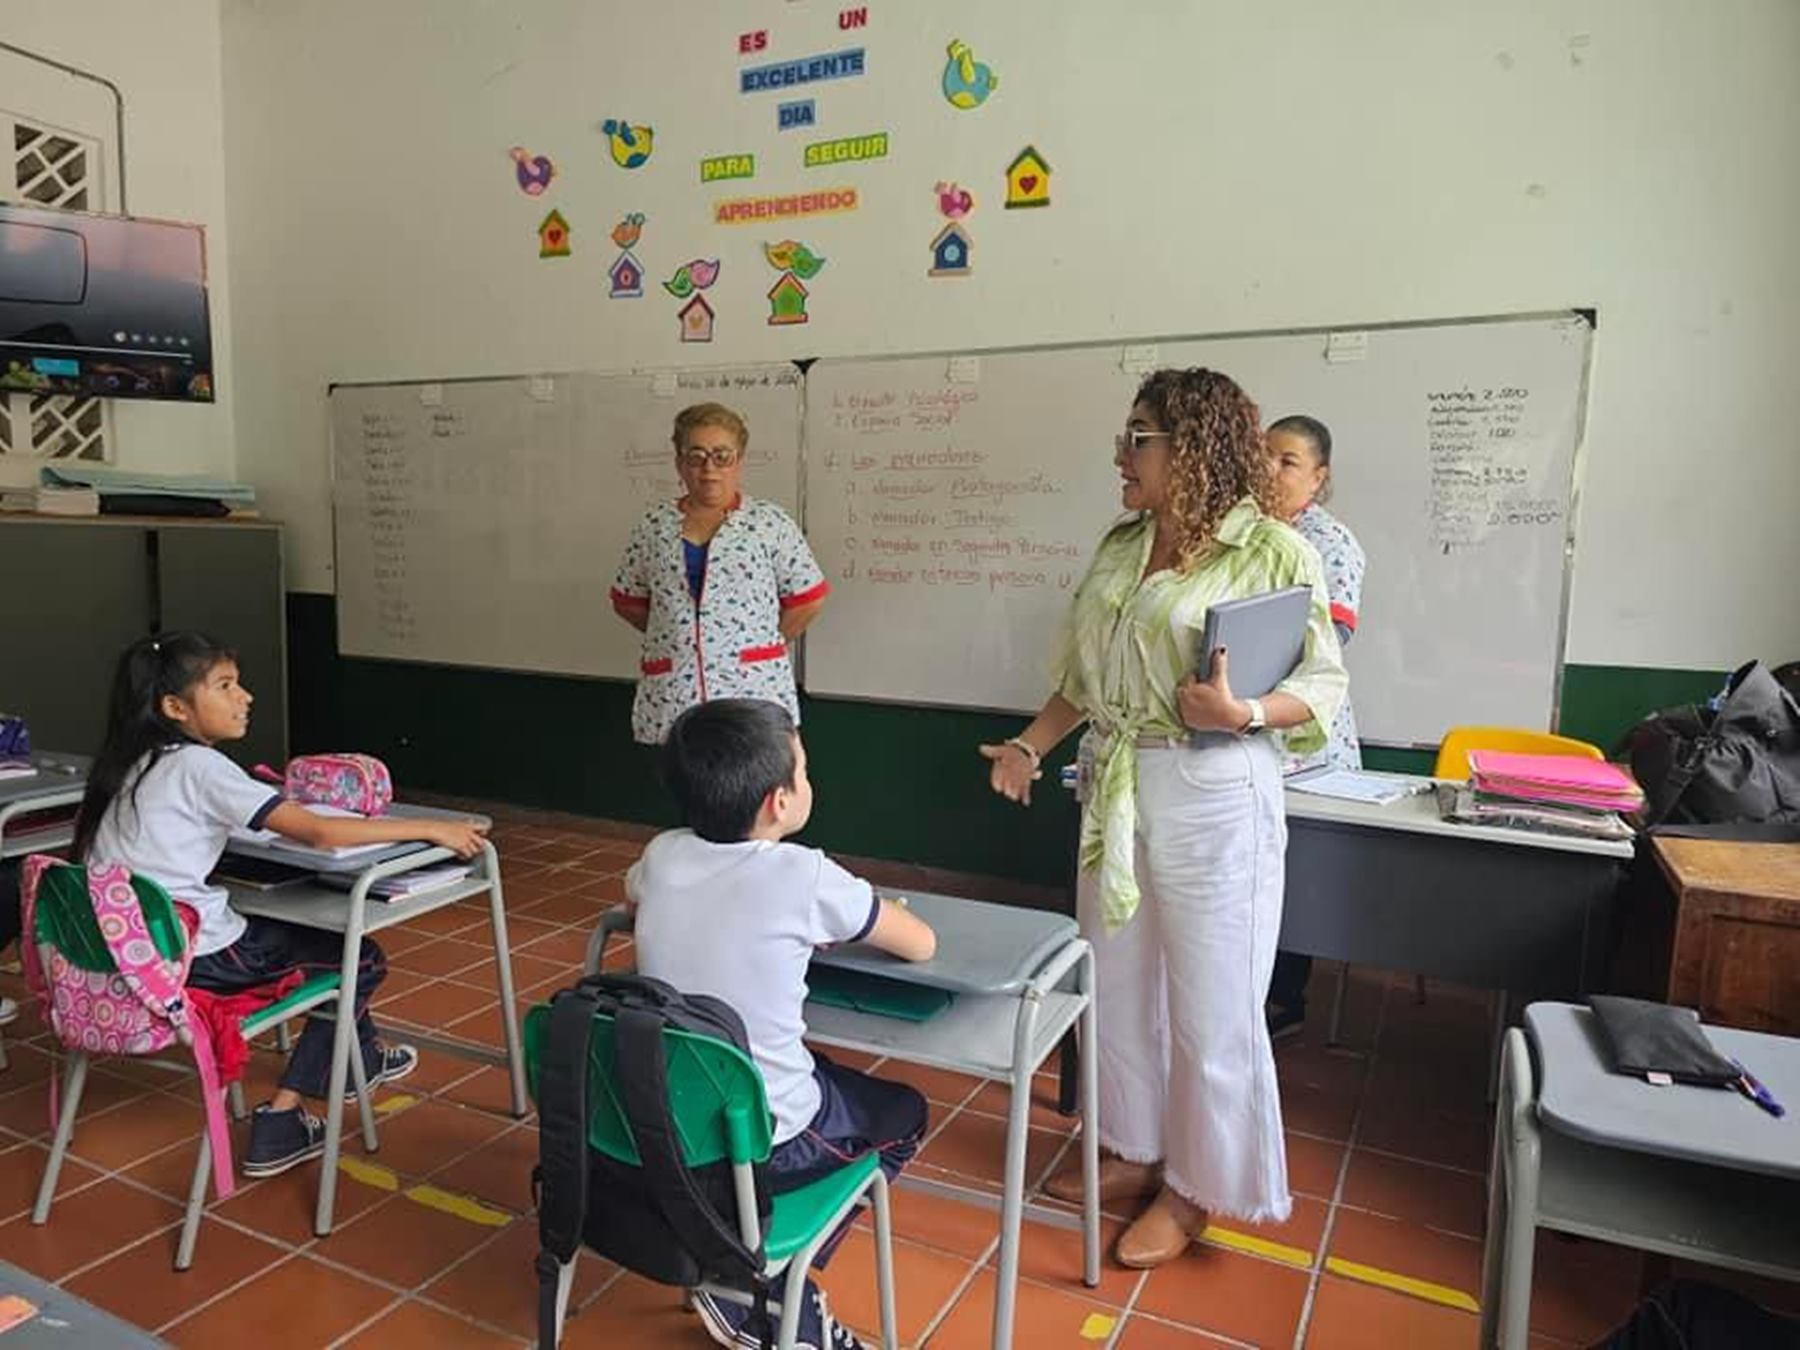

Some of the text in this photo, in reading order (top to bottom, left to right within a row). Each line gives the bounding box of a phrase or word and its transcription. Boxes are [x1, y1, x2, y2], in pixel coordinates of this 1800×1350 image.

[738, 7, 868, 53] ES UN
[740, 50, 866, 92] EXCELENTE
[778, 104, 815, 128] DIA
[702, 135, 887, 180] PARA SEGUIR
[716, 189, 858, 222] APRENDIENDO
